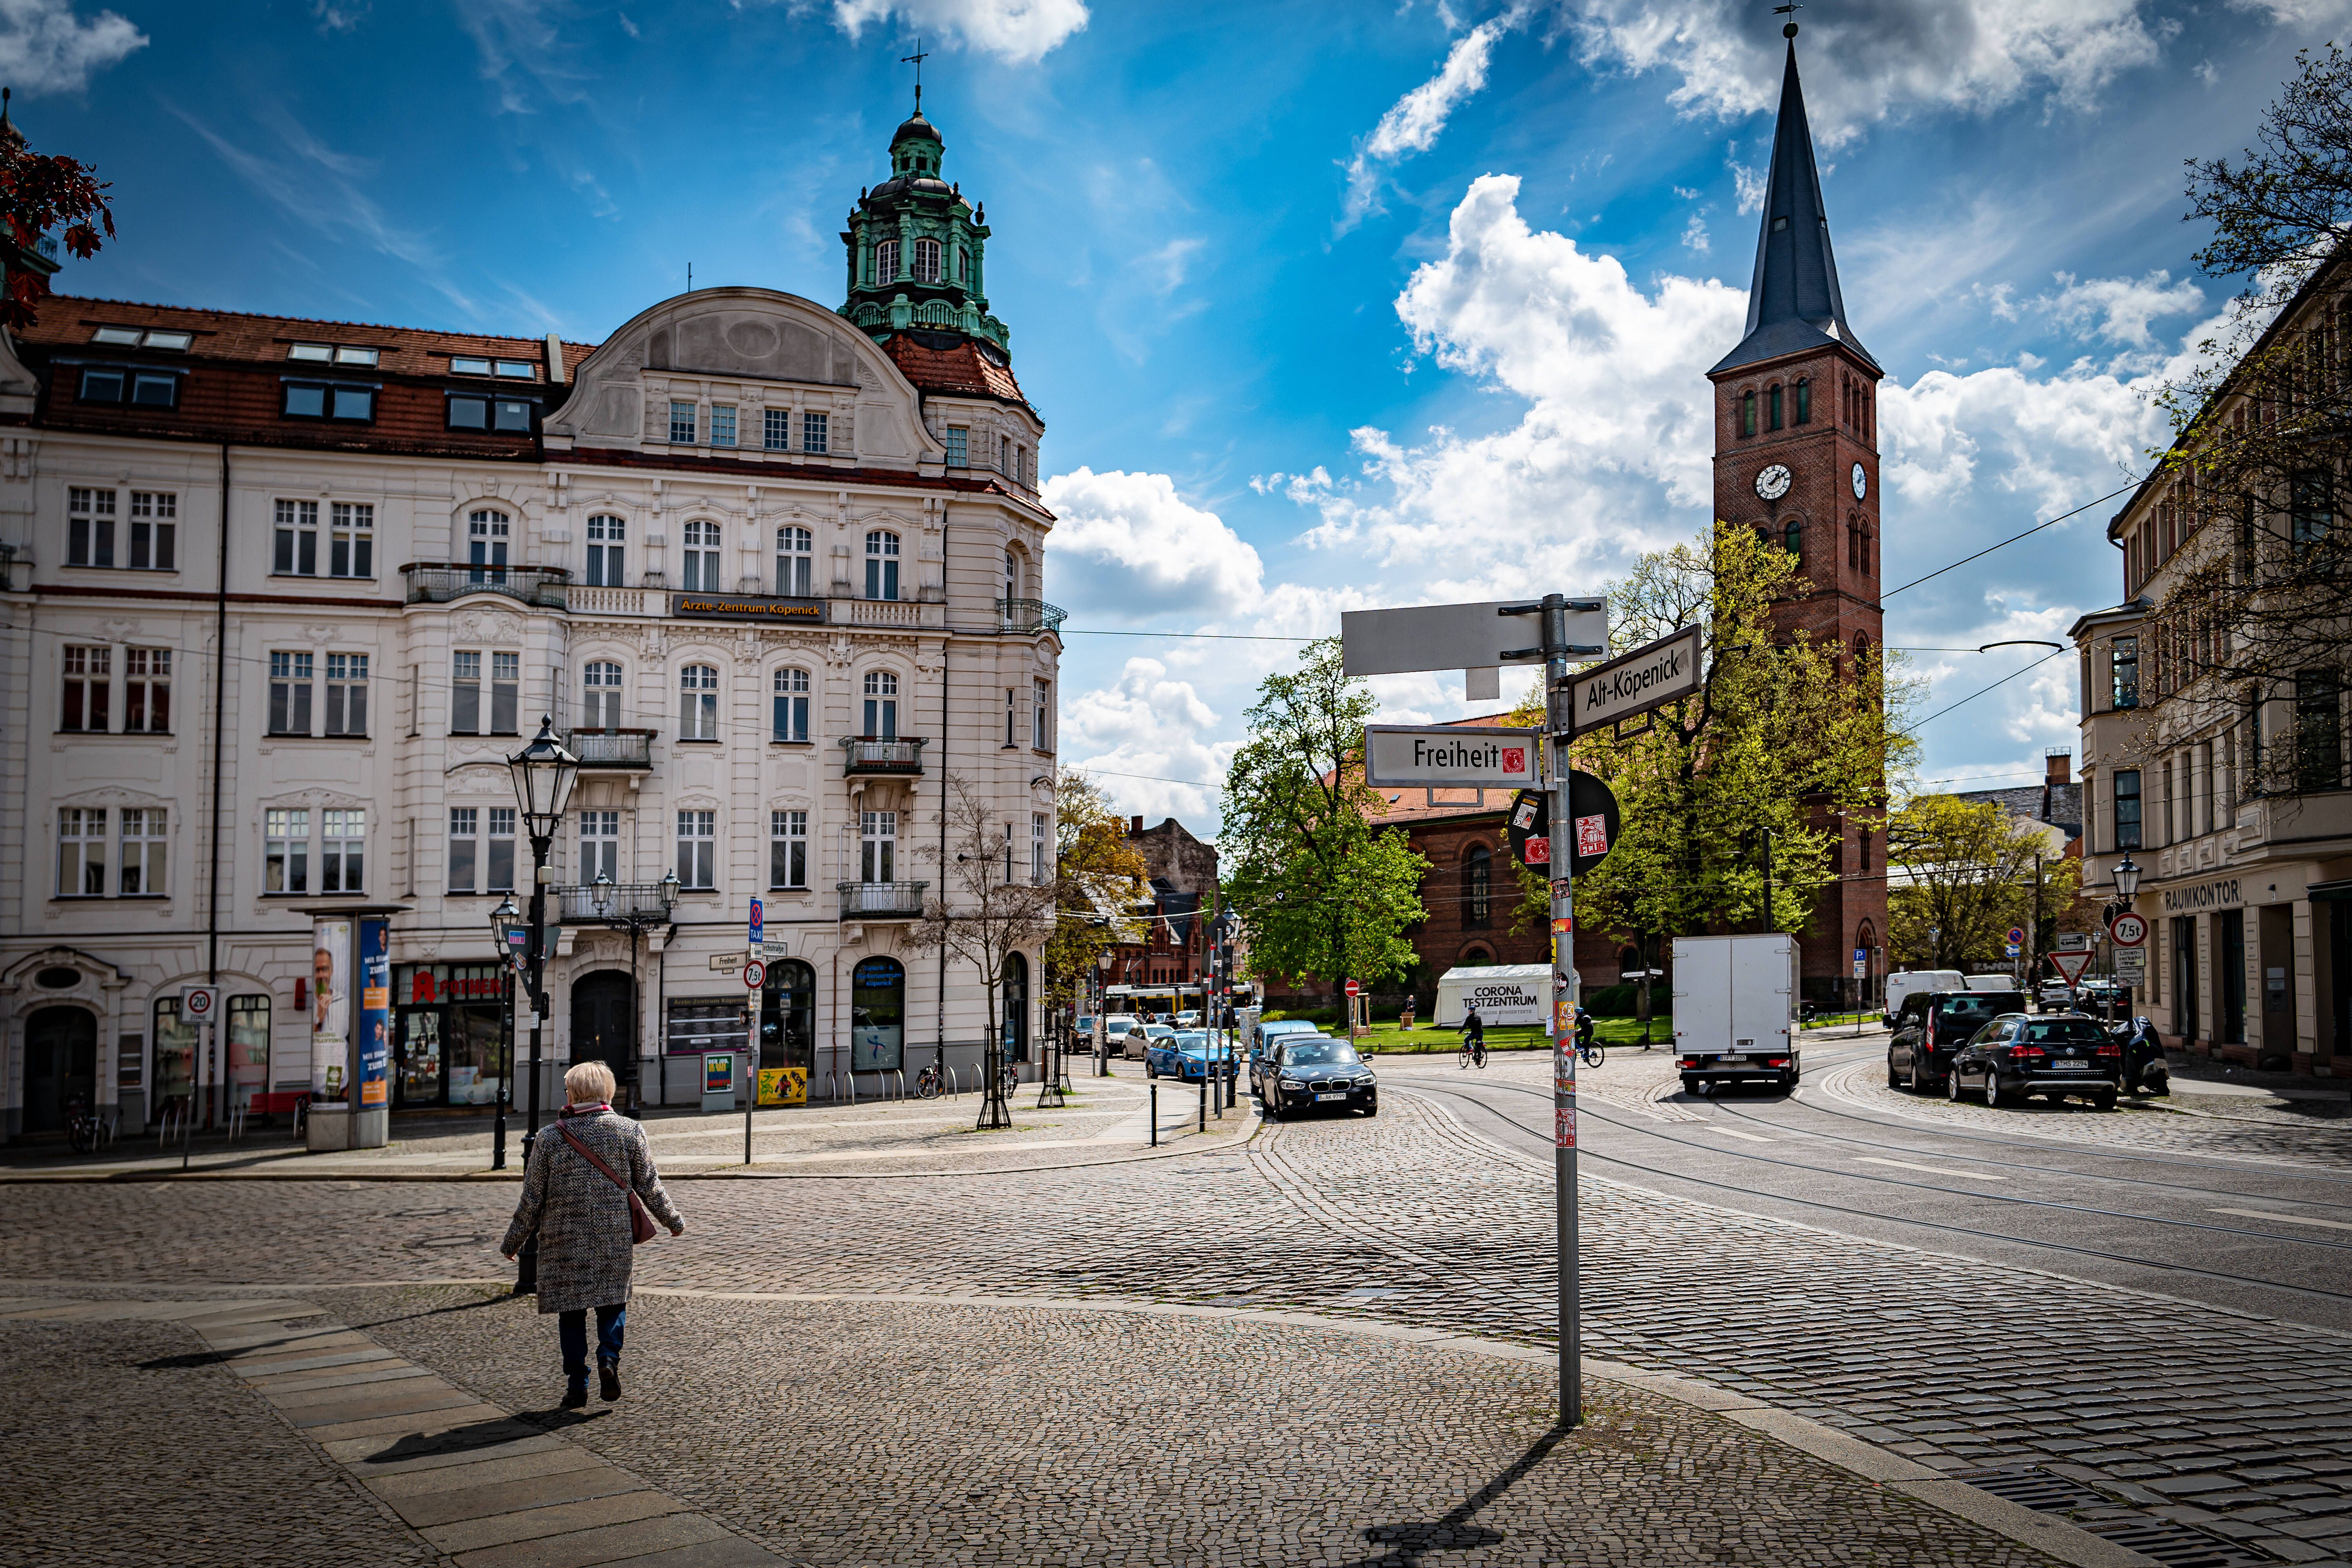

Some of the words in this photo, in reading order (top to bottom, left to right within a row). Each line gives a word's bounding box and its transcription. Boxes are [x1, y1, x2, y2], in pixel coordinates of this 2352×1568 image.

[682, 598, 766, 613] Ärzte-Zentrum
[769, 604, 820, 615] Köpenick
[1586, 649, 1679, 711] Alt-Köpenick
[1414, 739, 1499, 768] Freiheit
[1580, 842, 1606, 854] FCUB
[2165, 879, 2239, 911] RAUMKONTOR
[750, 929, 762, 939] TAXI
[2120, 924, 2140, 937] 7,5t
[764, 944, 784, 953] rchstraße
[719, 957, 737, 965] Freiheit
[748, 968, 760, 981] 7,5t
[1474, 985, 1523, 997] CORONA
[194, 996, 206, 1007] 20
[1462, 995, 1537, 1008] TESTZENTRUM
